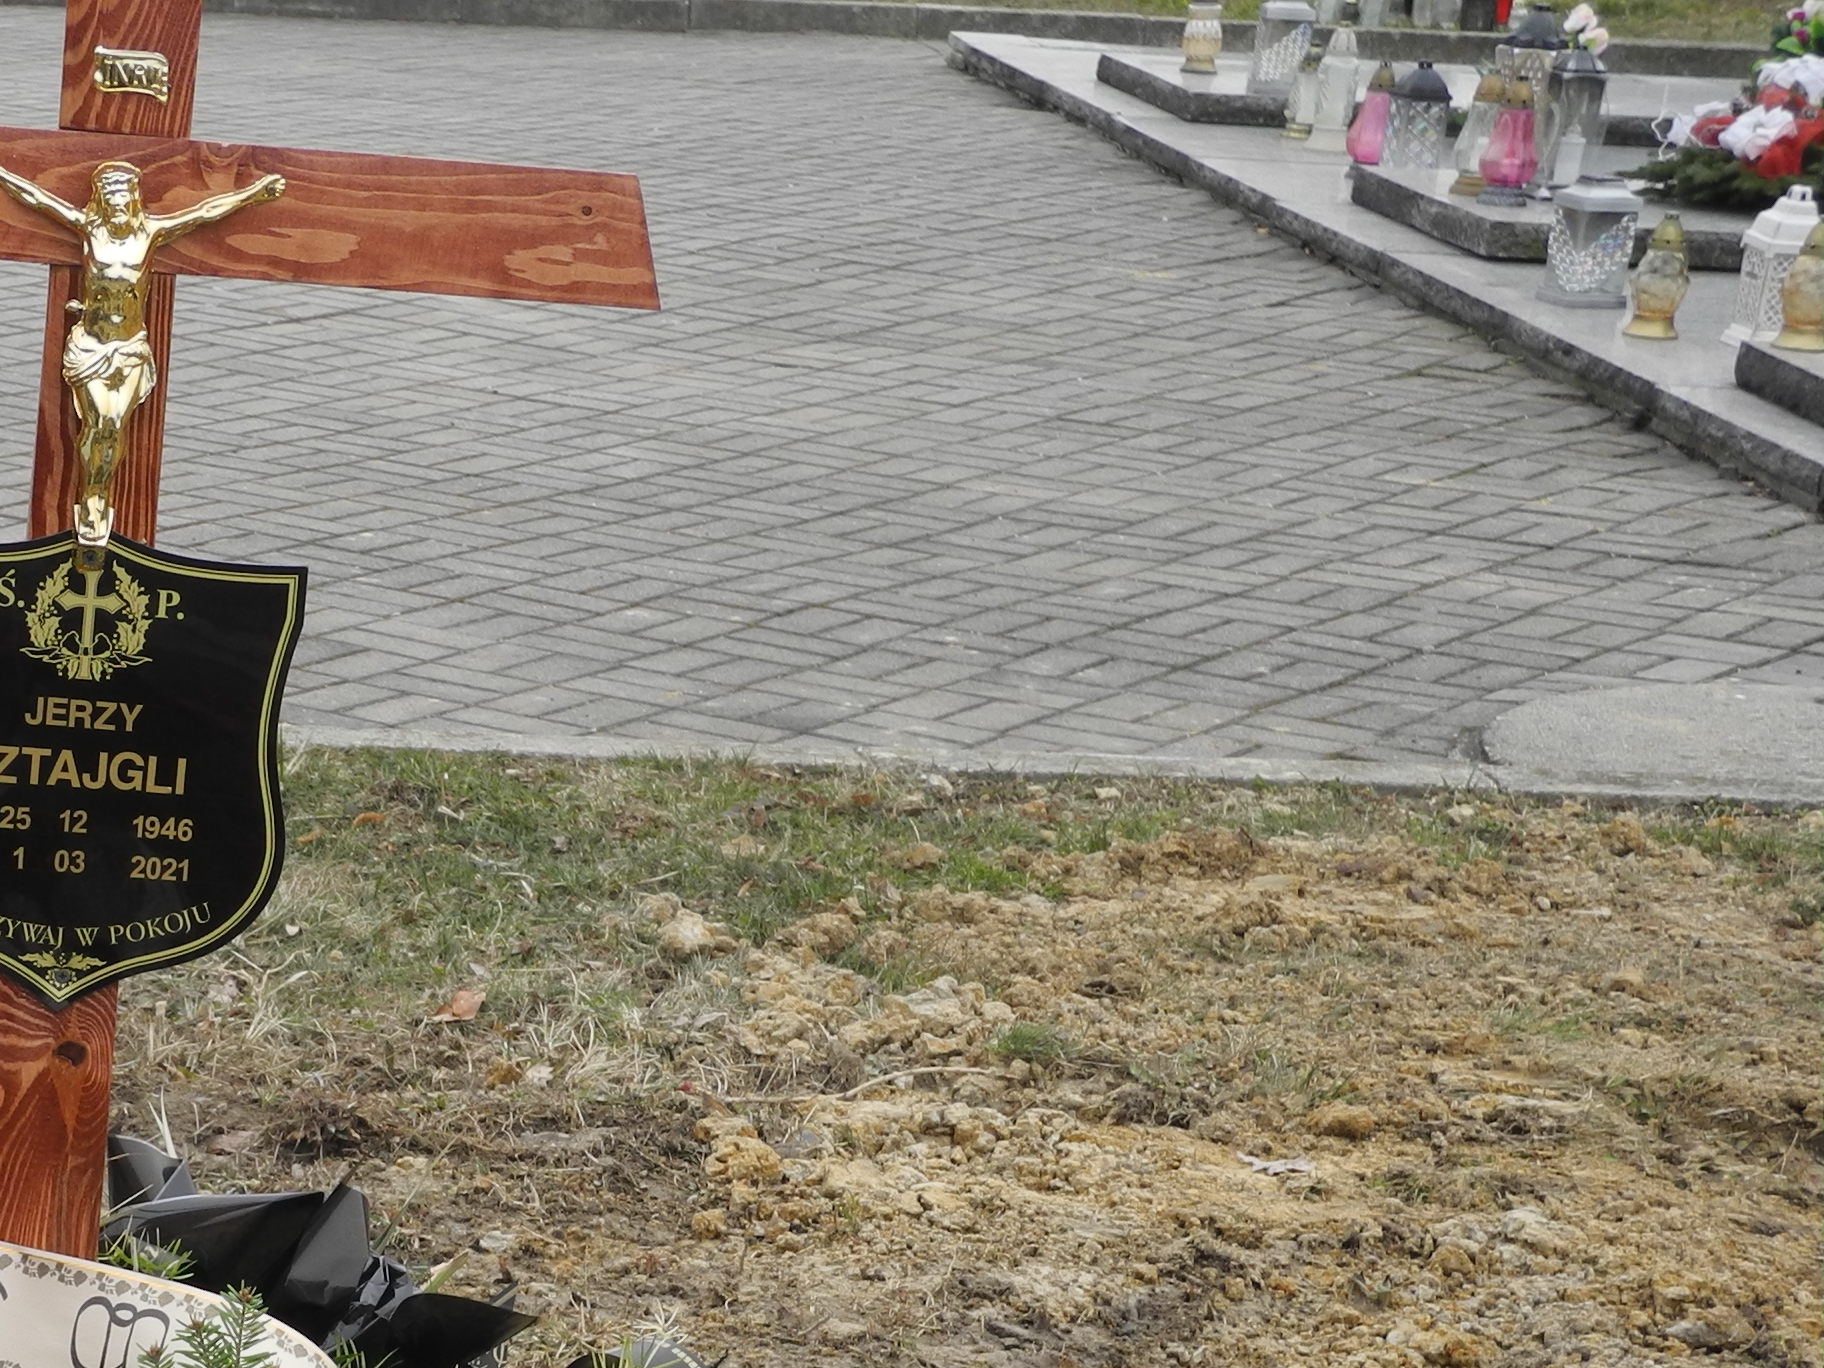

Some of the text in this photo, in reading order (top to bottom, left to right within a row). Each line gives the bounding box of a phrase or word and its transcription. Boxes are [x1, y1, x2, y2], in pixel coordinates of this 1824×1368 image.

[24, 696, 144, 733] JERZY
[59, 810, 88, 834] 12
[132, 815, 194, 842] 1946
[13, 846, 190, 882] 1 03 2021
[74, 927, 99, 947] W
[108, 901, 212, 945] POKOJU
